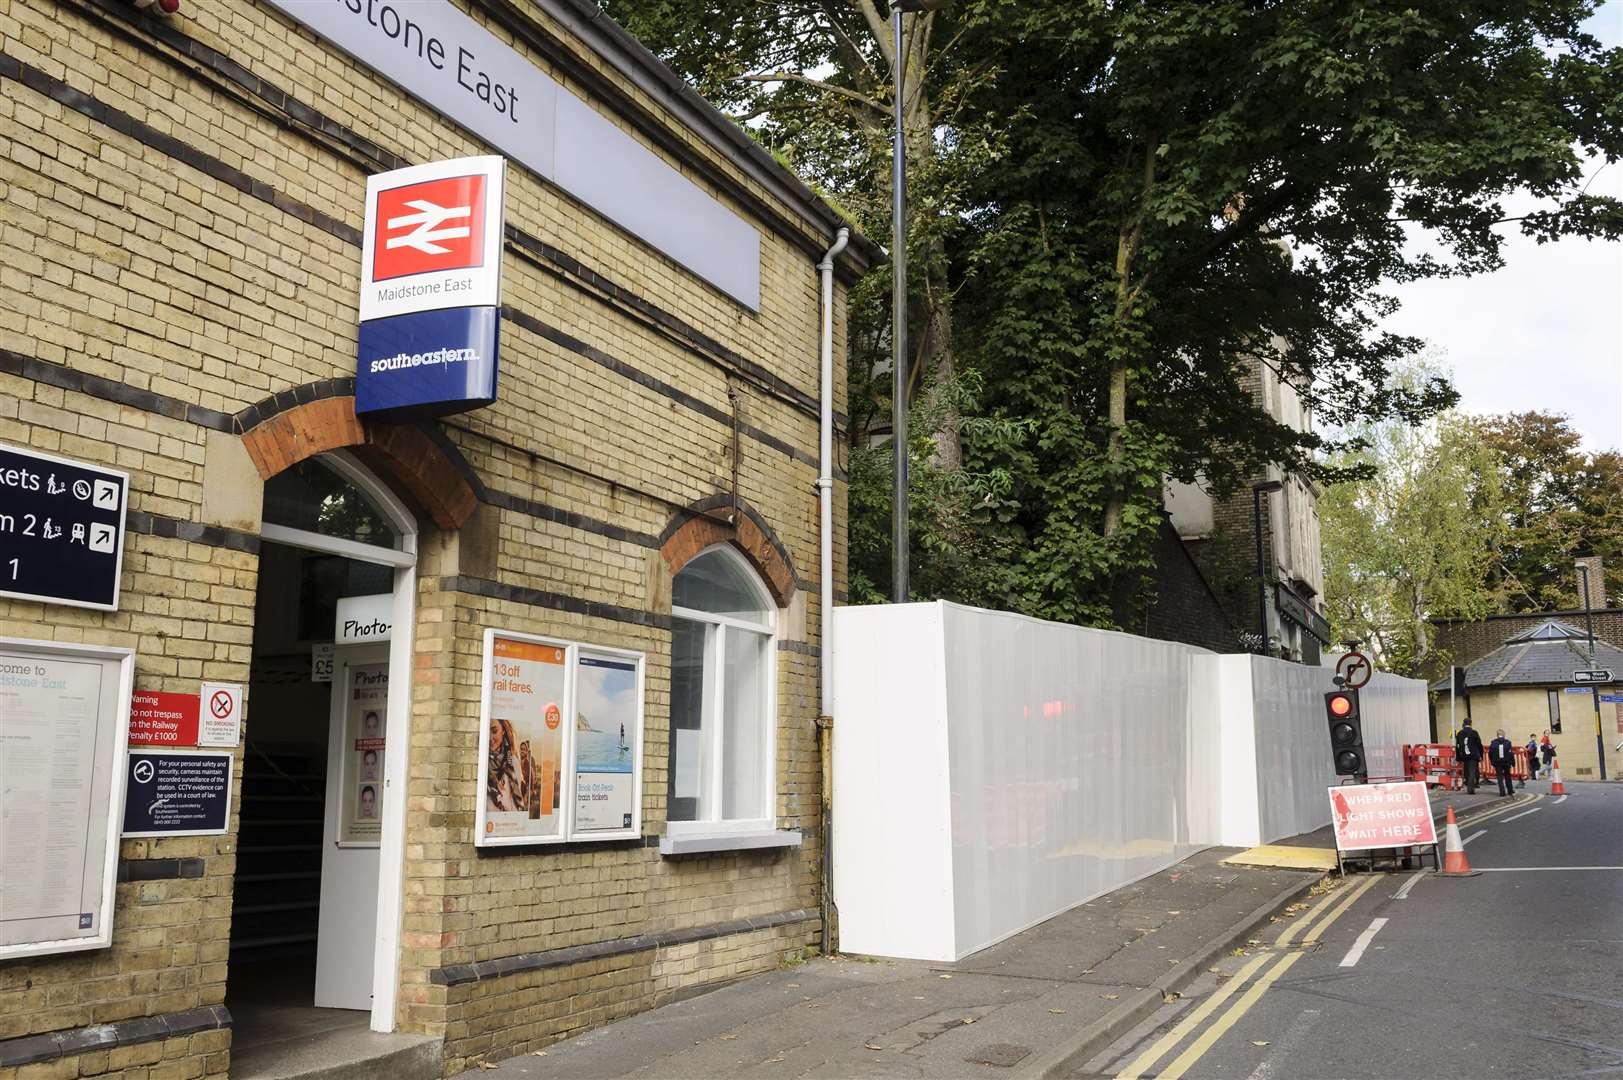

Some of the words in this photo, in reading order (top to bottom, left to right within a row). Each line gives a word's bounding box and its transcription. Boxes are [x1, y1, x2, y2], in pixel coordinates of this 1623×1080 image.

[457, 46, 519, 123] East
[378, 283, 440, 302] Maidstone
[444, 278, 472, 292] East
[22, 513, 37, 537] 2
[9, 558, 19, 580] 1
[34, 665, 46, 676] to
[508, 665, 520, 678] off
[494, 679, 507, 691] rail
[509, 680, 534, 694] fares.
[140, 710, 153, 718] not
[154, 711, 183, 720] trespass
[139, 720, 151, 728] the
[152, 720, 179, 731] Railway
[154, 732, 178, 741] £1000
[1347, 794, 1384, 805] WHEN
[1386, 792, 1411, 803] RED
[1377, 808, 1424, 820] SHOWS
[1348, 829, 1377, 839] WAIT
[1383, 825, 1422, 837] HERE
